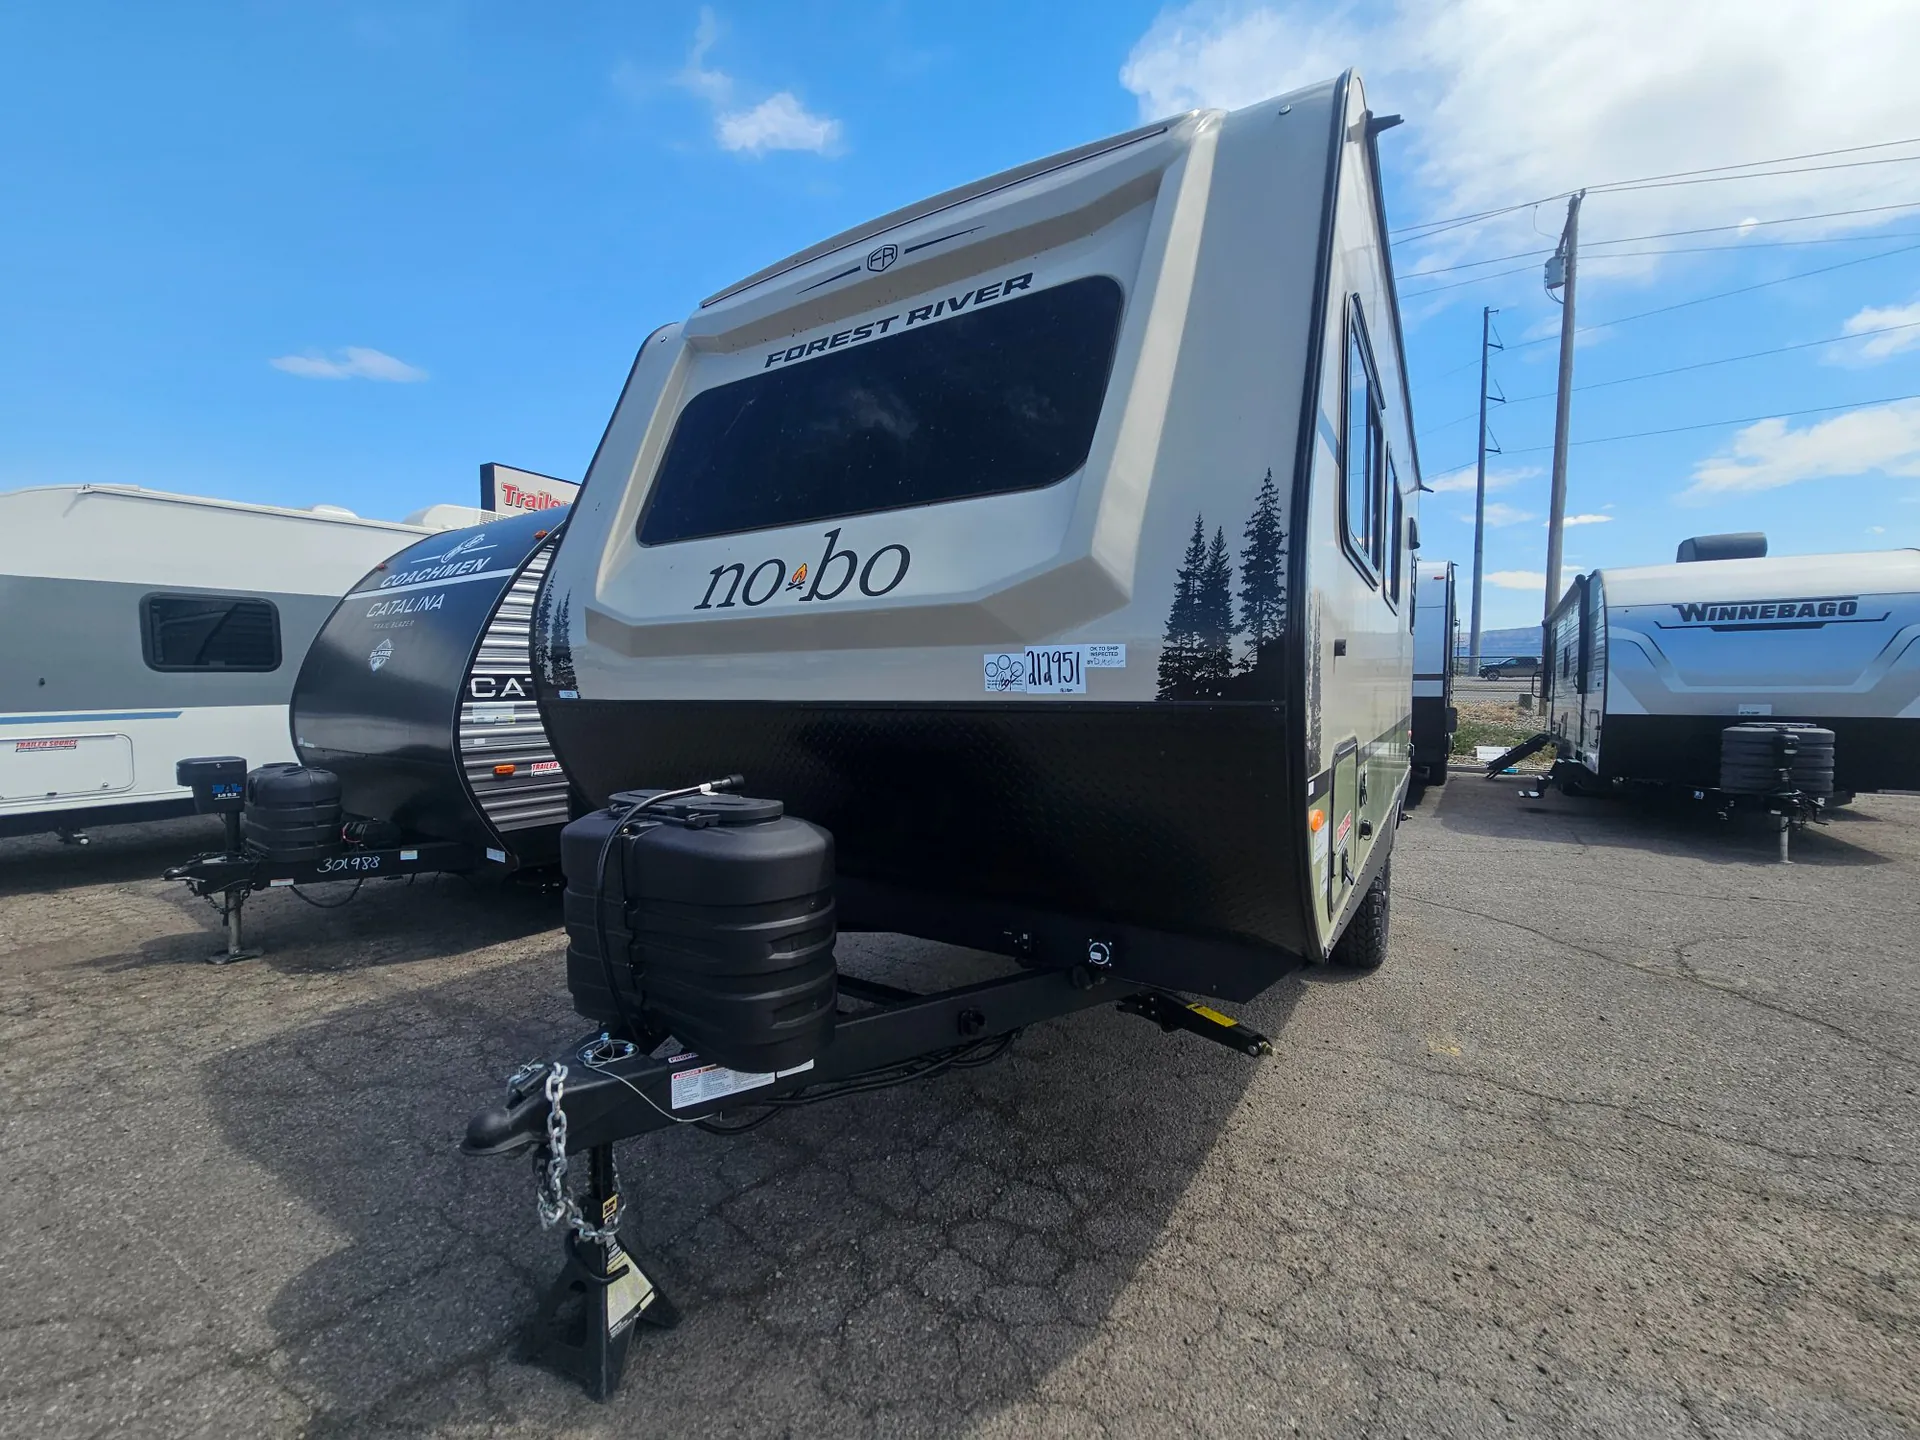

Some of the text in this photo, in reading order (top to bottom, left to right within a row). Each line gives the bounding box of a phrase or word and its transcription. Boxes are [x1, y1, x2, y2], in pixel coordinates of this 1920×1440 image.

[764, 272, 1034, 368] FOREST RIVER
[502, 483, 567, 510] Traile
[380, 557, 491, 588] COACHMEN
[366, 593, 445, 618] CATALINA
[1672, 601, 1858, 622] WINNEBAGO
[471, 677, 532, 697] CA
[317, 856, 380, 873] 301988
